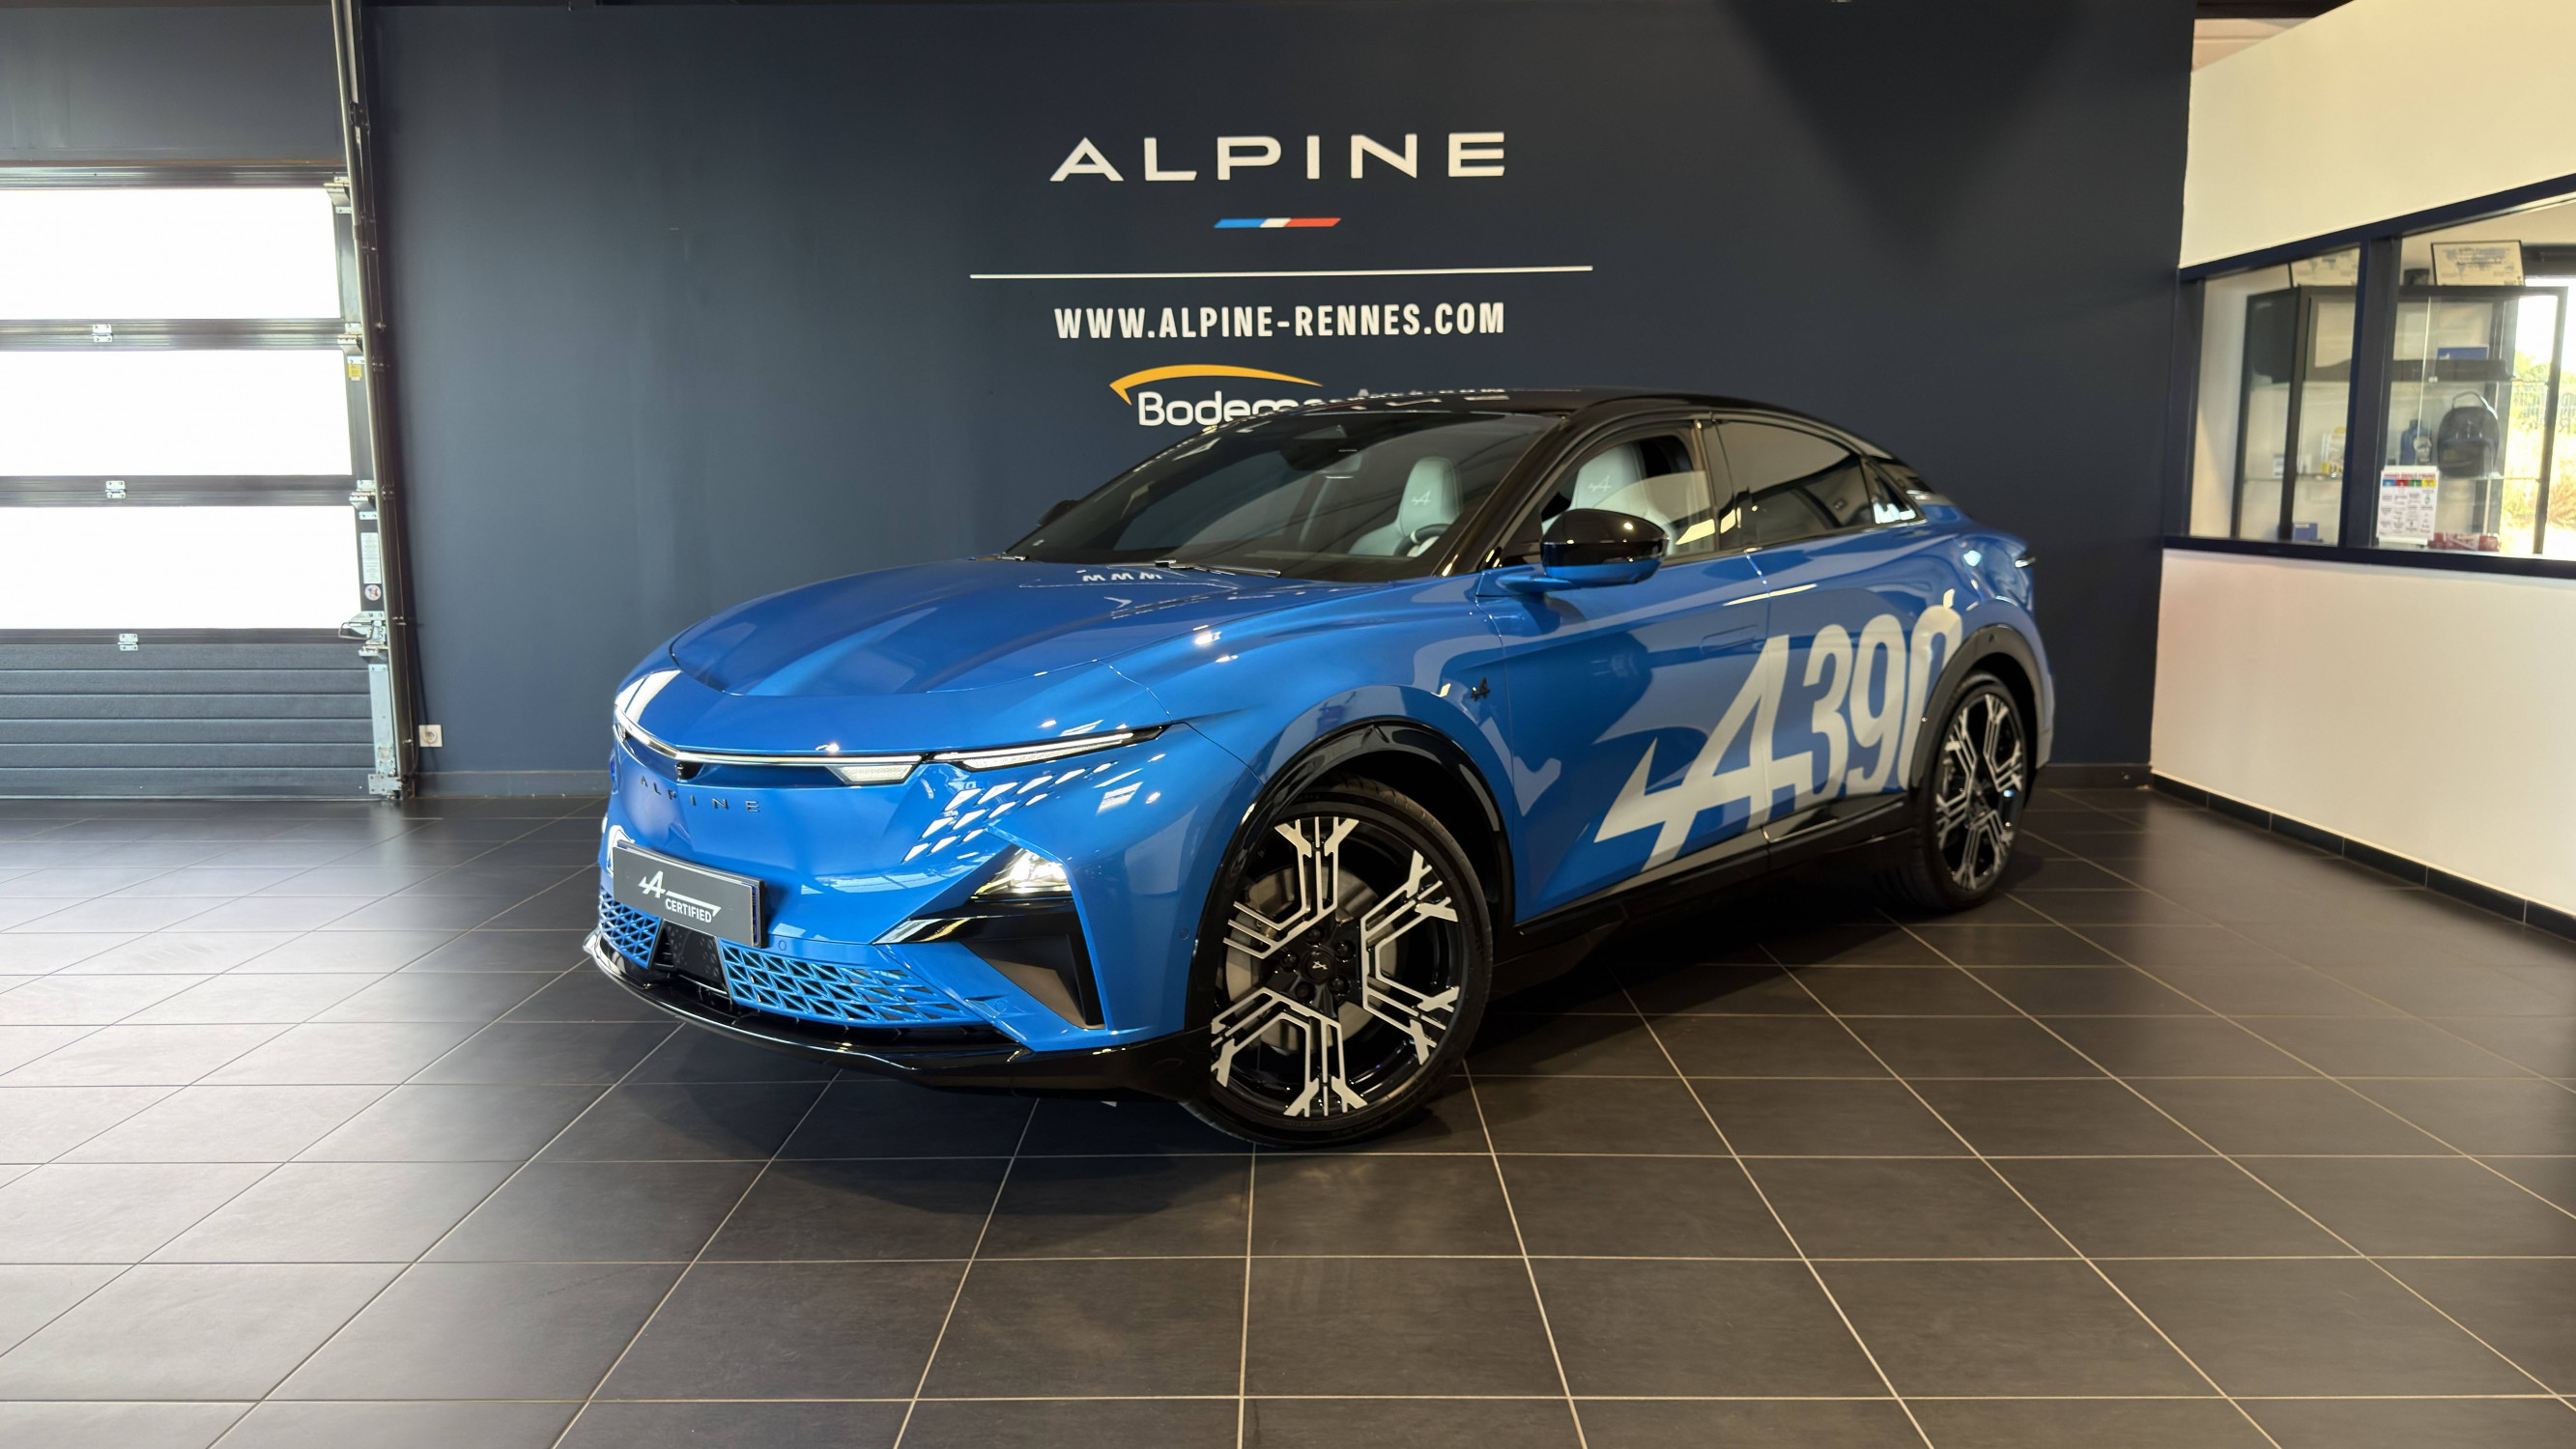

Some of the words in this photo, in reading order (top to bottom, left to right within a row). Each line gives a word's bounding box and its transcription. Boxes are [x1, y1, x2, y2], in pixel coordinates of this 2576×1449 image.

[1049, 131, 1504, 182] ALPINE
[1054, 301, 1504, 339] WWW.ALPINE-RENNES.COM
[640, 775, 760, 812] ALPINE
[665, 897, 713, 923] CERTIFIED
